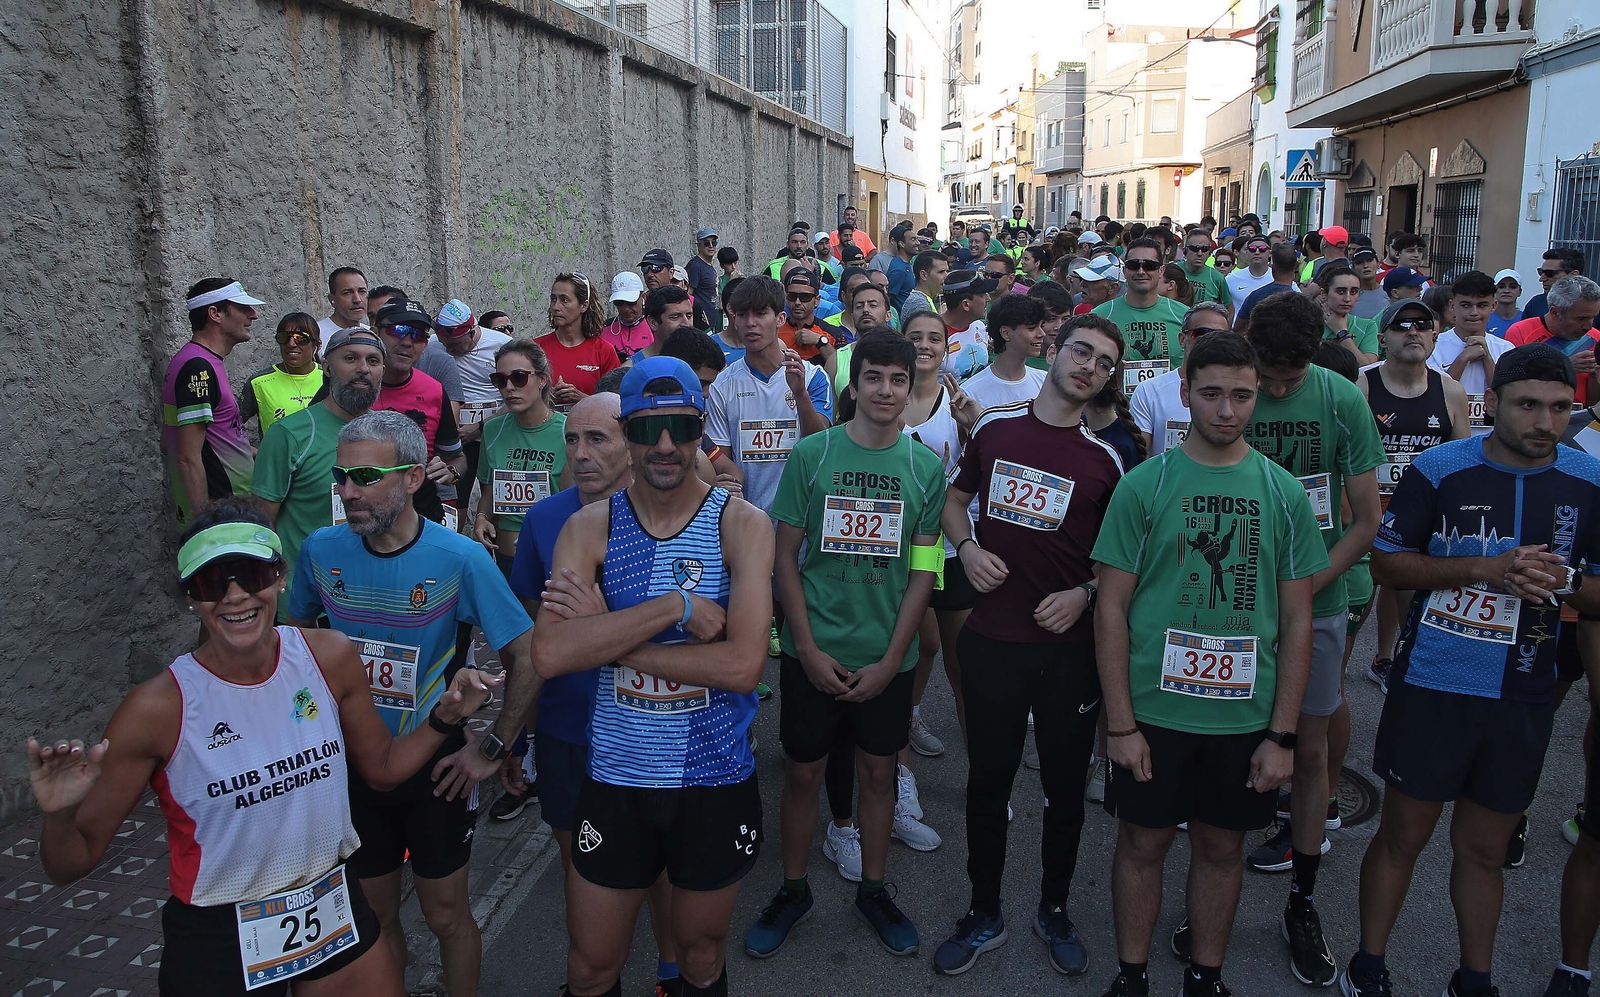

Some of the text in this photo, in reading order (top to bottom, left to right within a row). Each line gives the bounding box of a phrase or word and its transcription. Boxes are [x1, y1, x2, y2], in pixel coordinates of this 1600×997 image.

[1131, 322, 1166, 331] CROSS
[470, 411, 484, 423] 71
[752, 431, 784, 448] 407
[1255, 421, 1320, 437] CROSS
[1380, 435, 1442, 446] ALENCIA
[513, 448, 555, 463] CROSS
[842, 471, 901, 492] CROSS
[1022, 469, 1043, 483] CROSS
[504, 482, 535, 501] 306
[1004, 480, 1049, 511] 325
[855, 501, 875, 511] CROSS
[1182, 497, 1190, 513] XLII
[1192, 495, 1260, 516] CROSS
[840, 513, 882, 538] 382
[1185, 517, 1197, 528] 16
[1552, 505, 1575, 555] NING
[1245, 518, 1260, 612] AUXILIADORA
[1233, 563, 1247, 611] MARIA
[1446, 586, 1498, 622] 375
[363, 642, 385, 657] CROSS
[1201, 638, 1225, 651] CROSS
[1183, 651, 1234, 681] 328
[1516, 644, 1536, 672] MC
[365, 659, 394, 689] 18
[206, 739, 340, 798] CLUB TRIATLÓN
[235, 763, 331, 810] ALGECIRAS
[264, 888, 315, 915] XLII CROSS
[337, 912, 346, 922] XL
[280, 904, 321, 953] 25
